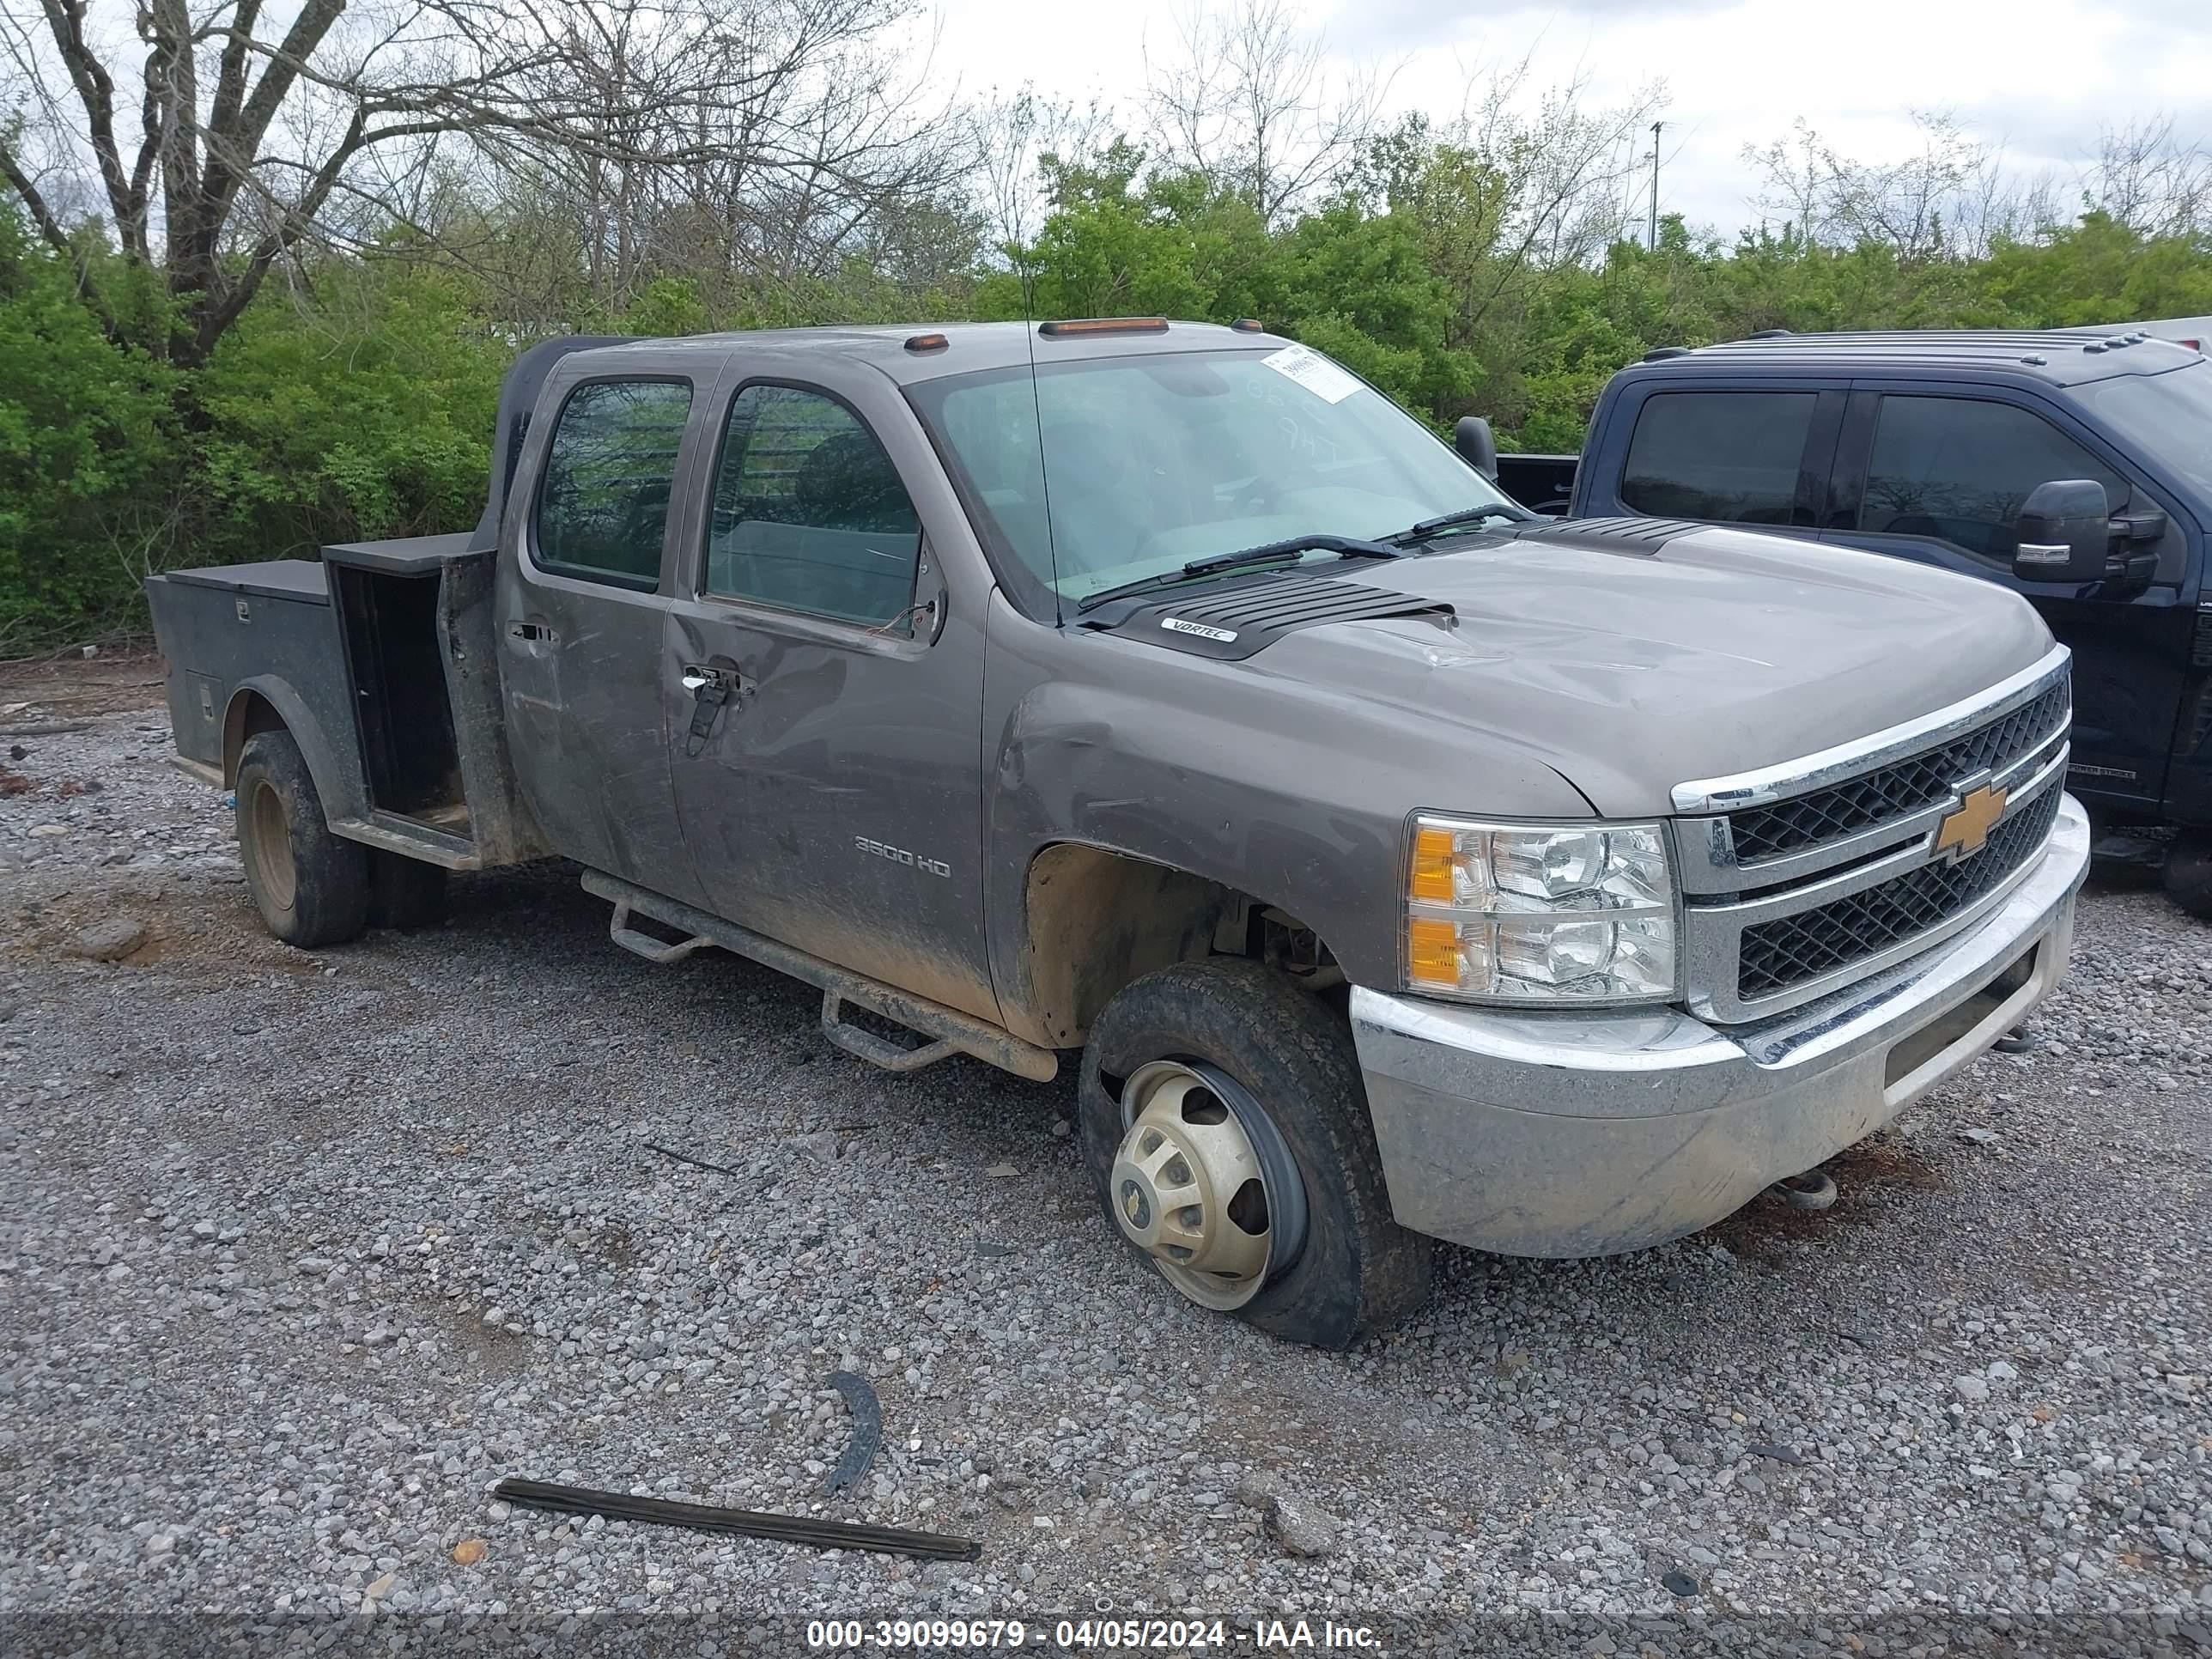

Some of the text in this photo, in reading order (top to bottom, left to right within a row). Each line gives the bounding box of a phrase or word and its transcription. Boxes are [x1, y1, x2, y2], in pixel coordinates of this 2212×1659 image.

[1172, 620, 1229, 639] VORTEC
[2069, 763, 2134, 778] POWER STROKE
[854, 835, 951, 878] 3500 HD
